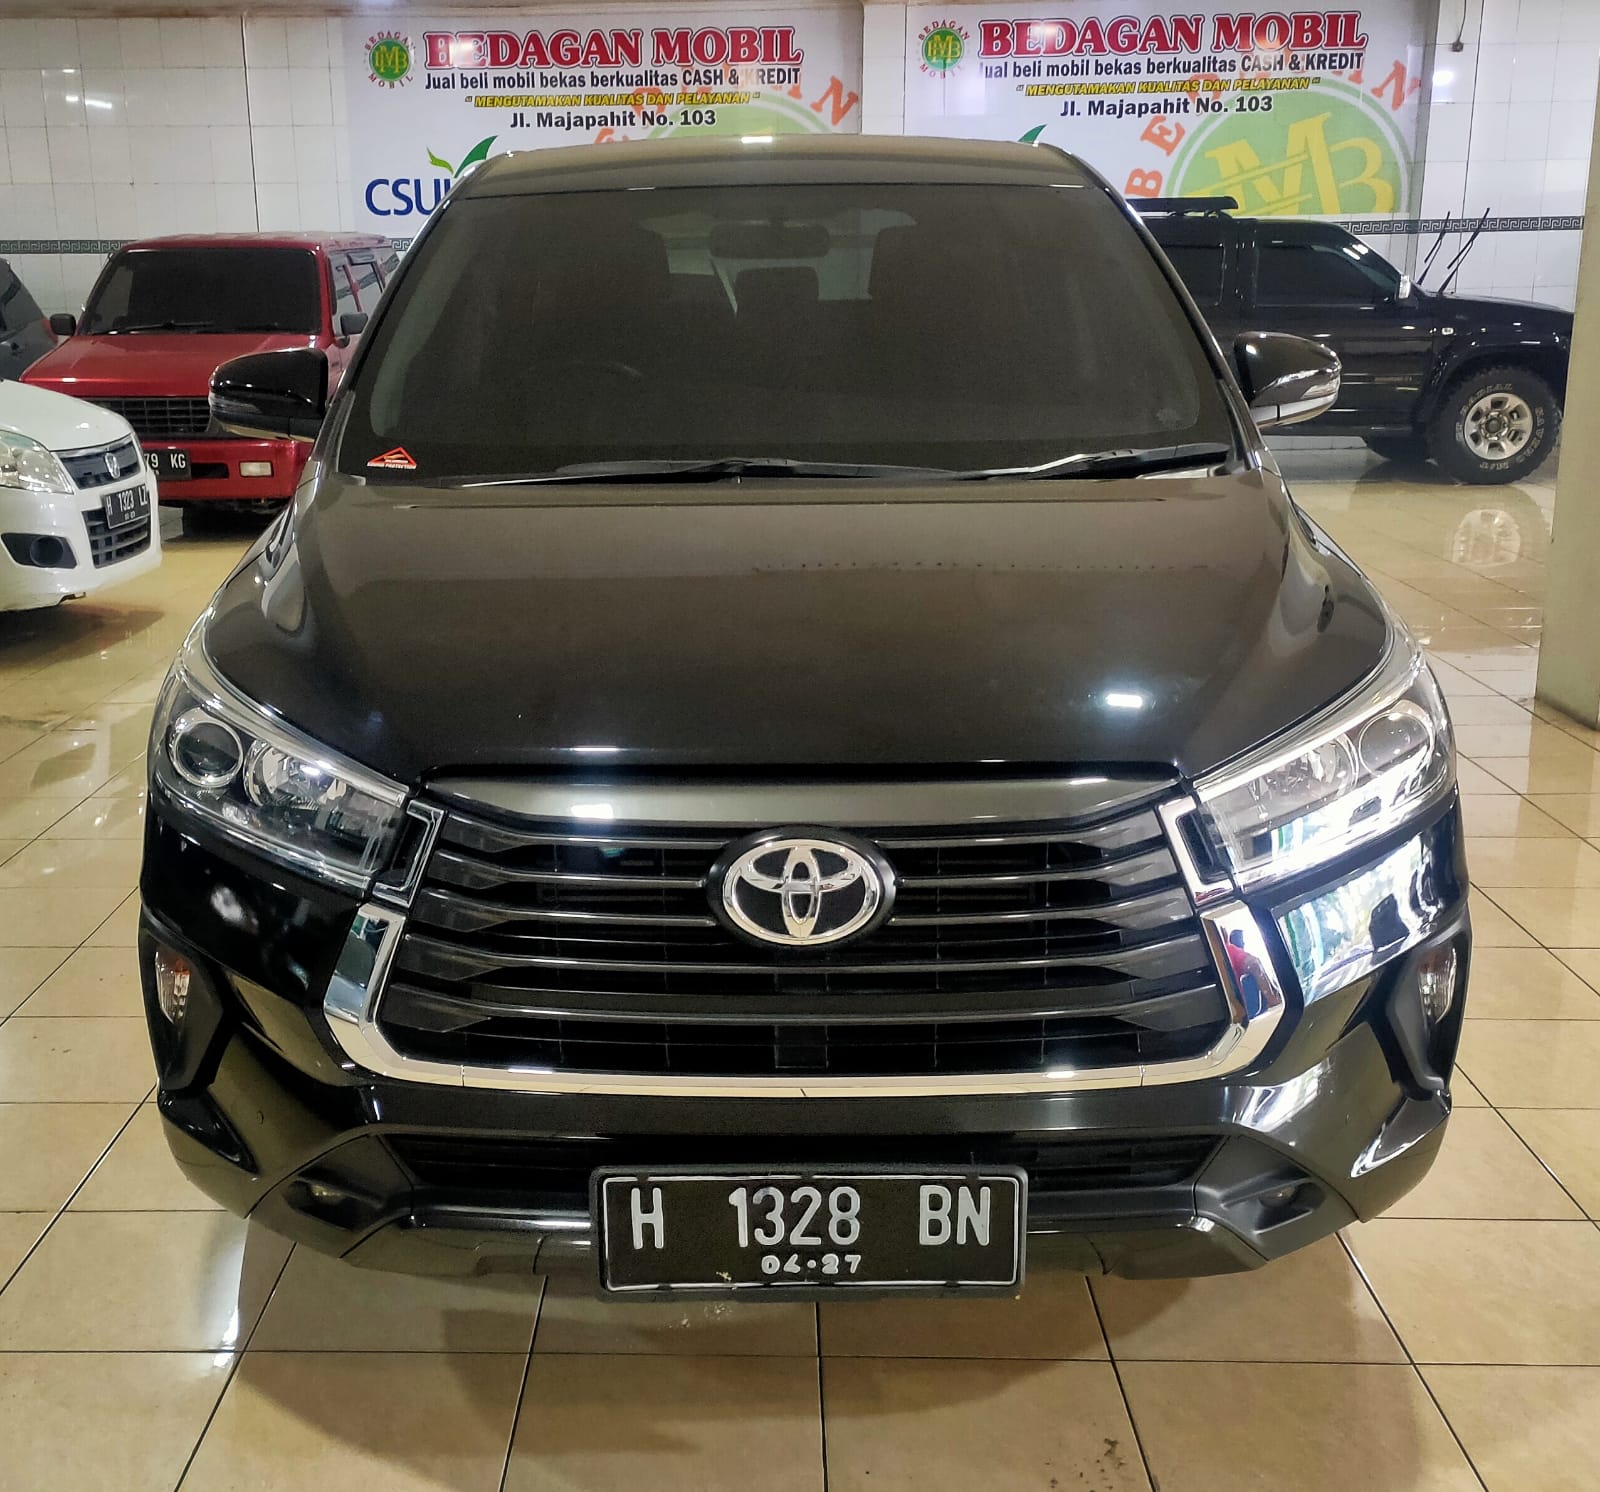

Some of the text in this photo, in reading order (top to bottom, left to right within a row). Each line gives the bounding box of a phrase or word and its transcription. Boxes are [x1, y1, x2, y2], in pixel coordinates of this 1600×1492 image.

[364, 30, 416, 50] BEDAGA
[978, 11, 1369, 58] BEDAGAN MOBIL
[423, 26, 804, 69] BEDAGAN MOBIL
[1013, 60, 1041, 78] beli
[1046, 59, 1089, 77] mobil
[1095, 57, 1142, 76] bekas
[1146, 55, 1236, 75] berkualitas
[1241, 54, 1283, 72] CASH
[1289, 53, 1300, 70] &
[1305, 52, 1364, 70] KREDIT
[425, 72, 456, 89] Jual
[460, 71, 488, 89] beli
[493, 71, 535, 88] mobil
[540, 71, 586, 88] bekas
[591, 69, 678, 87] berkualitas
[682, 68, 723, 86] CASH
[728, 69, 739, 85] &
[1025, 82, 1136, 96] MENGUTAMAKAN
[1137, 80, 1201, 94] KUALITAS
[1202, 79, 1231, 92] DAN
[1233, 77, 1310, 91] PELAYANAN
[474, 95, 581, 107] MENGUTAMAKAN
[584, 94, 643, 106] KUALITAS
[646, 93, 674, 105] DAN
[676, 92, 750, 105] PELAYANAN
[1061, 96, 1273, 118] Jl. Majapahit No. 103
[510, 110, 716, 130] Jl. Majapahit No. 103
[170, 453, 186, 469] KG
[106, 495, 113, 516] H
[117, 489, 135, 512] 1323
[631, 1184, 990, 1249] H 1328 BN
